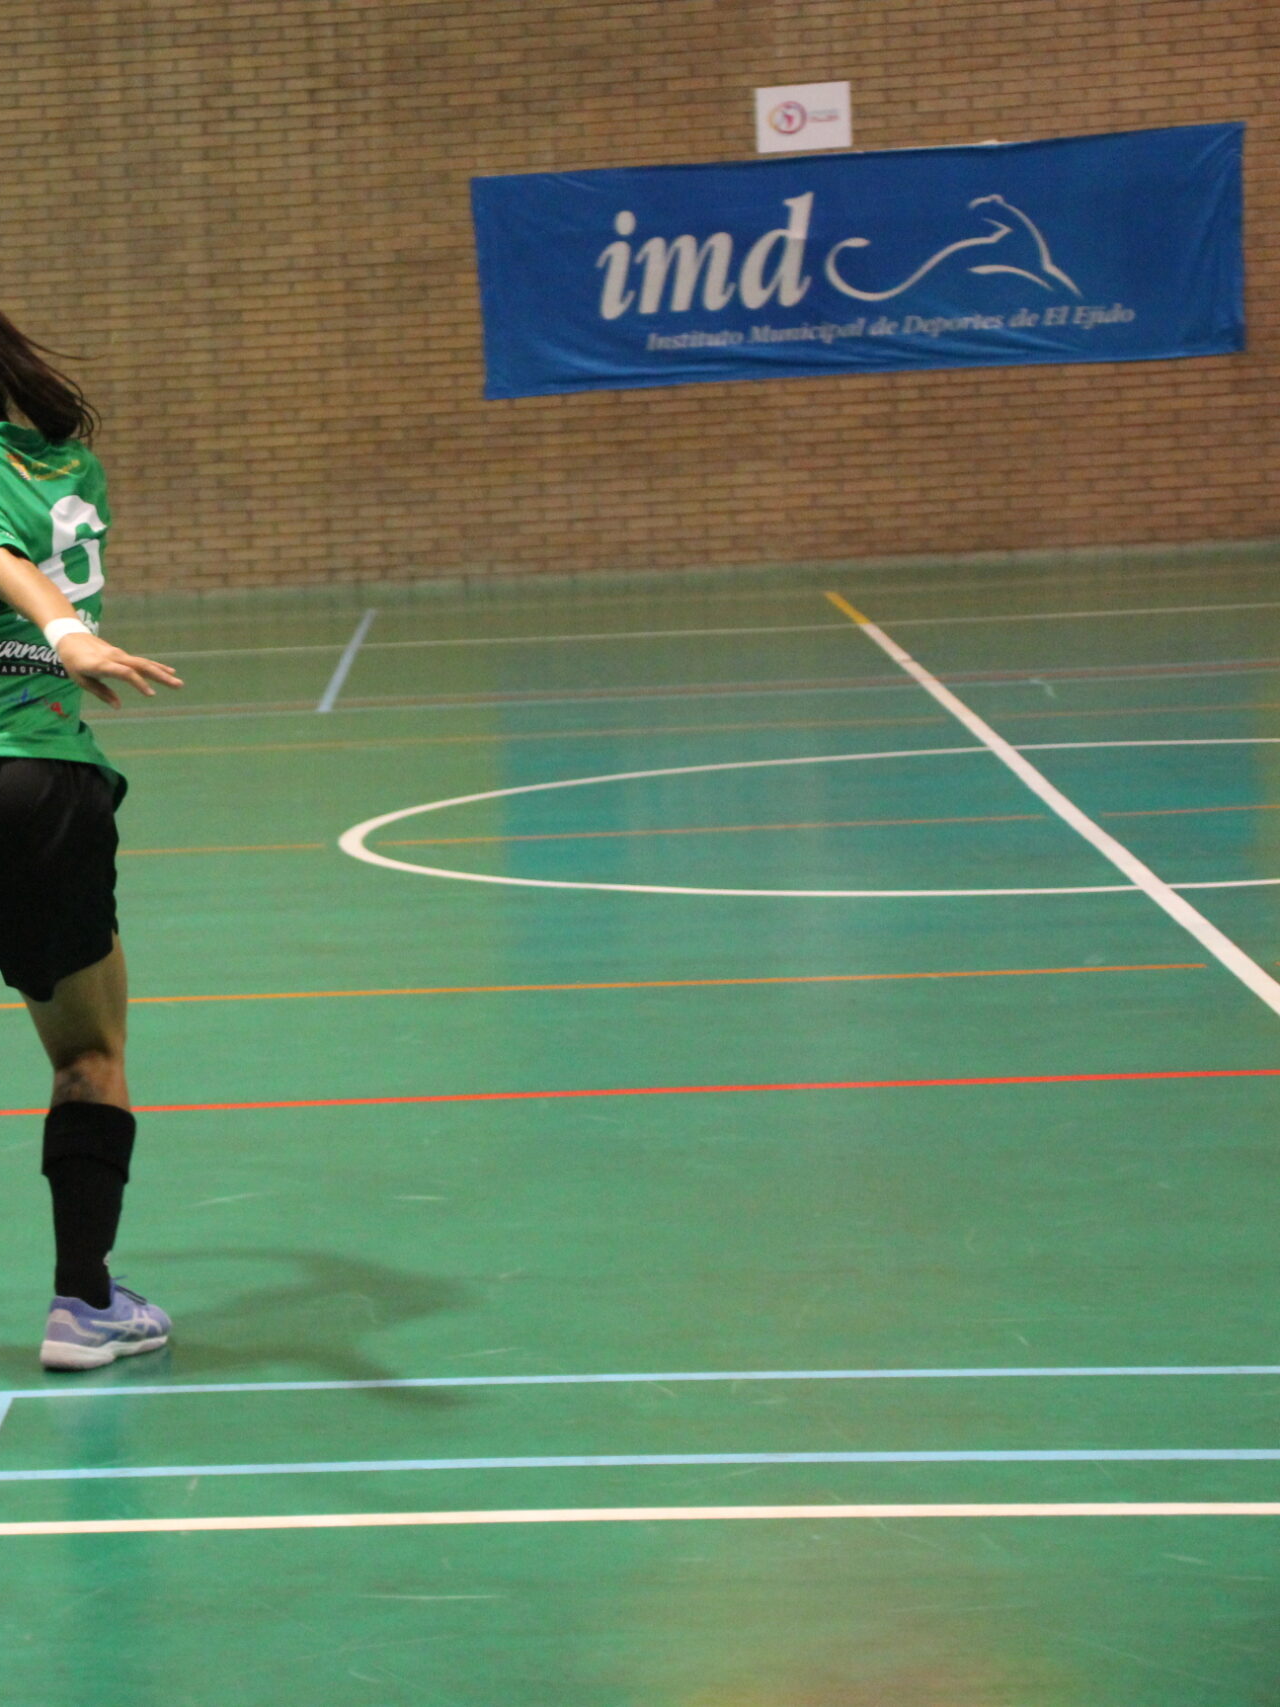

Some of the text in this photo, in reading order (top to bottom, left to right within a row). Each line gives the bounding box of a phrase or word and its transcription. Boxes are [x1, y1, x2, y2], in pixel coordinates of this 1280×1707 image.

[596, 191, 814, 320] imd
[645, 302, 1136, 350] Instituto Municipal de Deportes de El Ejido
[38, 494, 107, 603] 6
